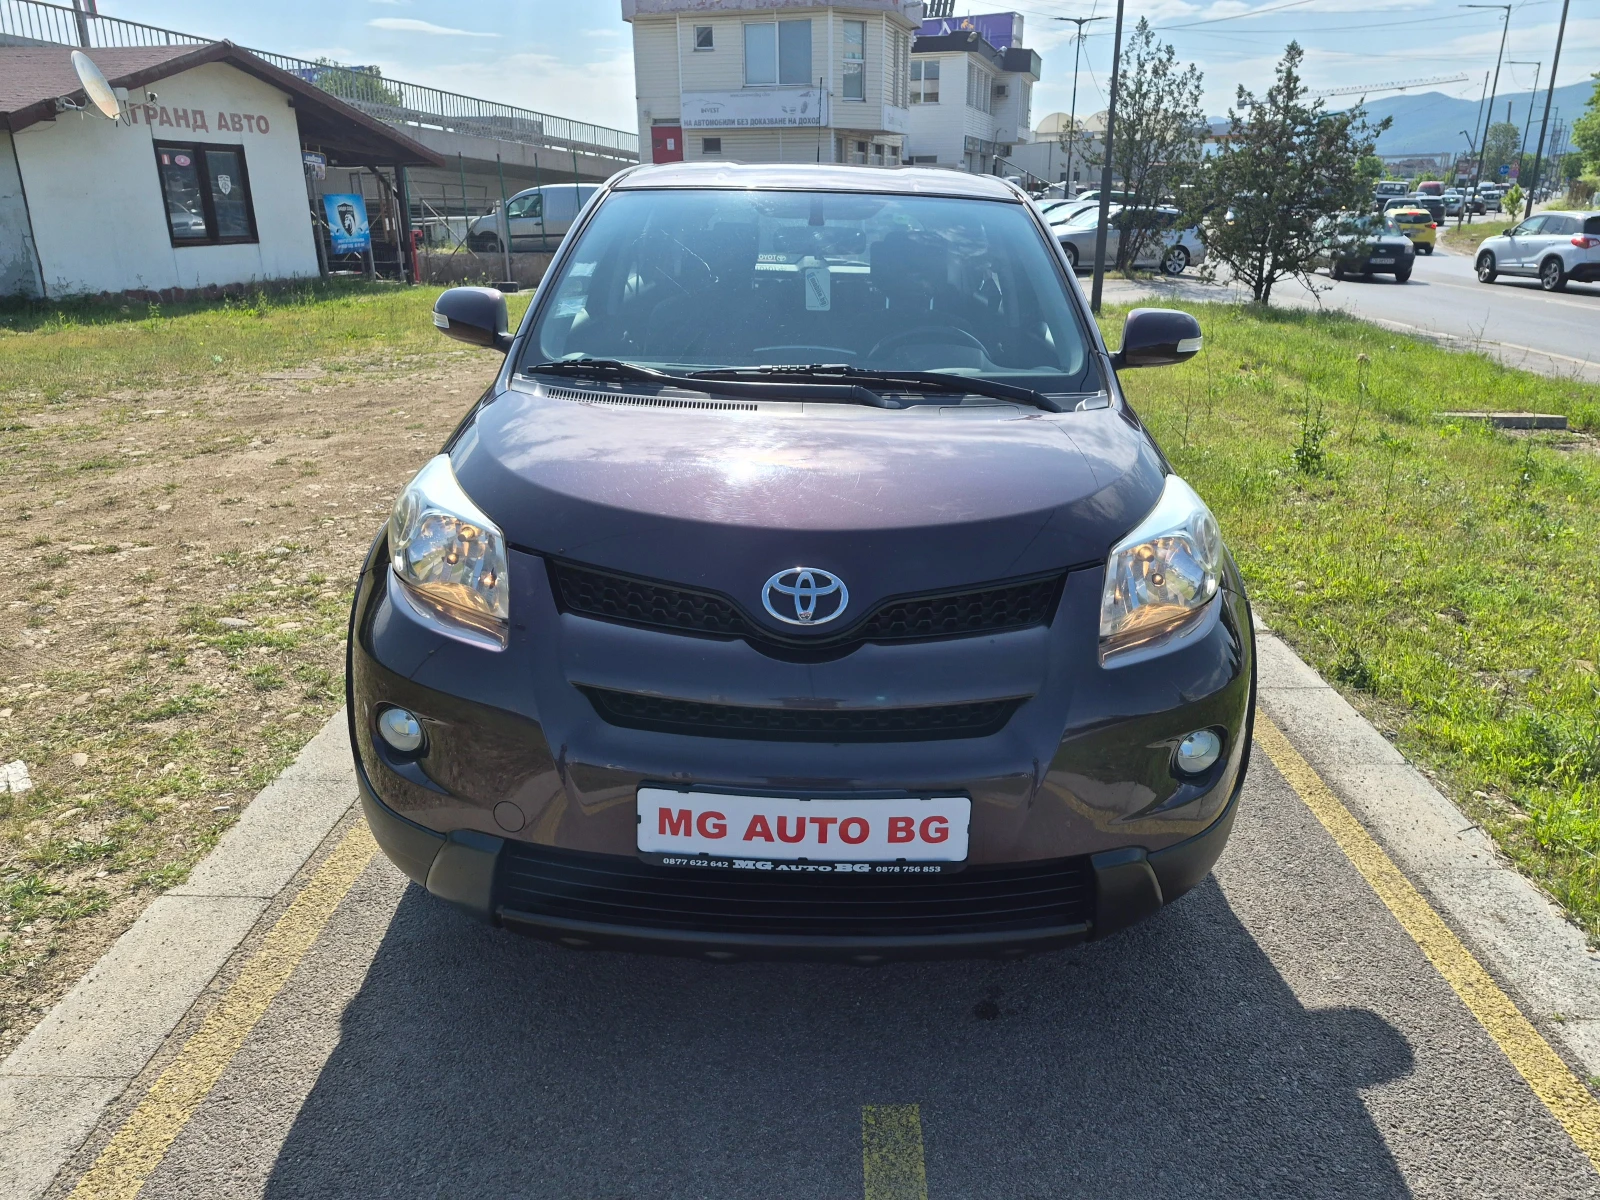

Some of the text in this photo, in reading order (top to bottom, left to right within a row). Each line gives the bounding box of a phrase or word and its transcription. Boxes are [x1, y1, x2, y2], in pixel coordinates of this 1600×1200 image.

[129, 102, 270, 135] ГРАНД АВТО
[693, 118, 736, 127] АВТОМОБИЛИ
[737, 118, 749, 126] БЕЗ
[749, 117, 787, 126] ДОКАЗВАНЕ
[788, 117, 798, 125] НА
[810, 276, 828, 306] mobile.bg
[657, 806, 950, 845] MG AUTO BG
[663, 857, 941, 874] 0877 622 642 MG AUTO BG 0878 756 853
